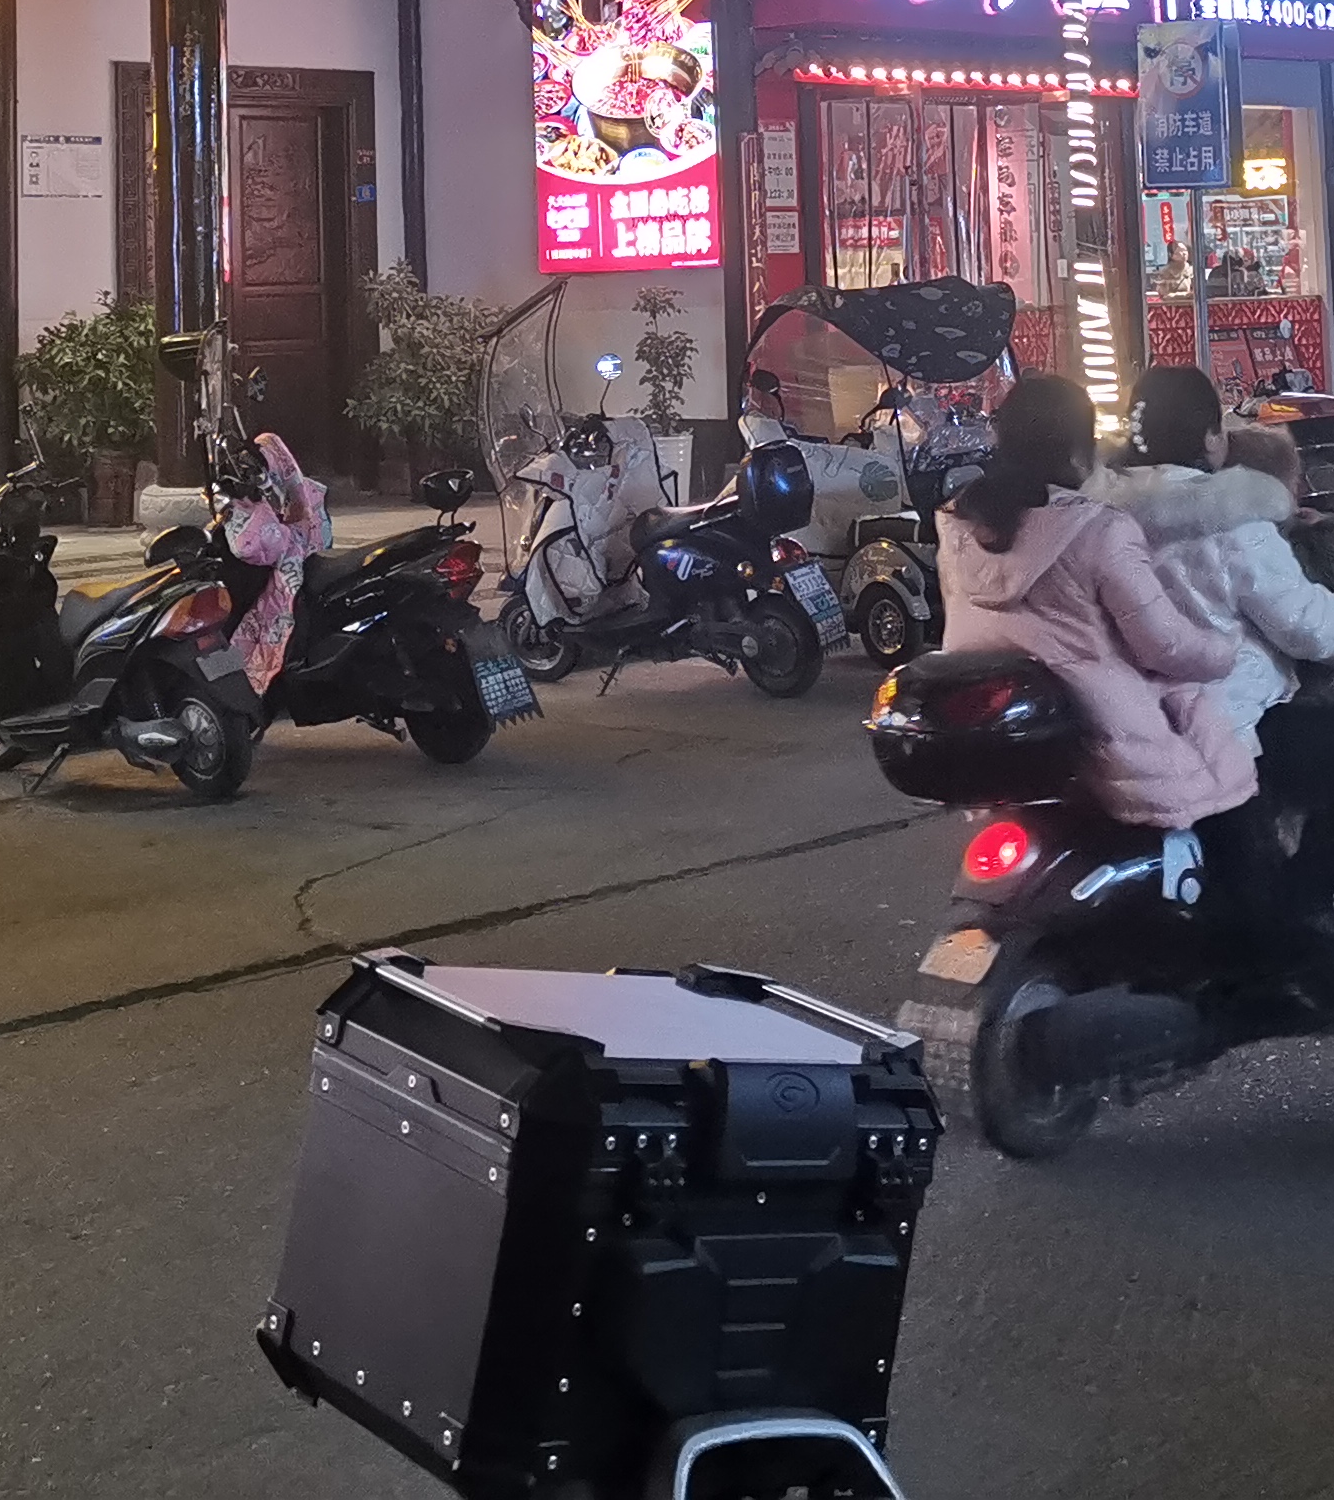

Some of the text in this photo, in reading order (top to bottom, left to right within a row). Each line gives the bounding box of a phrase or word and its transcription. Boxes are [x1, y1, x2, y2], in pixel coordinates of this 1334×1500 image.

[1155, 109, 1213, 138] 消防车道
[1152, 146, 1215, 173] 禁止占用
